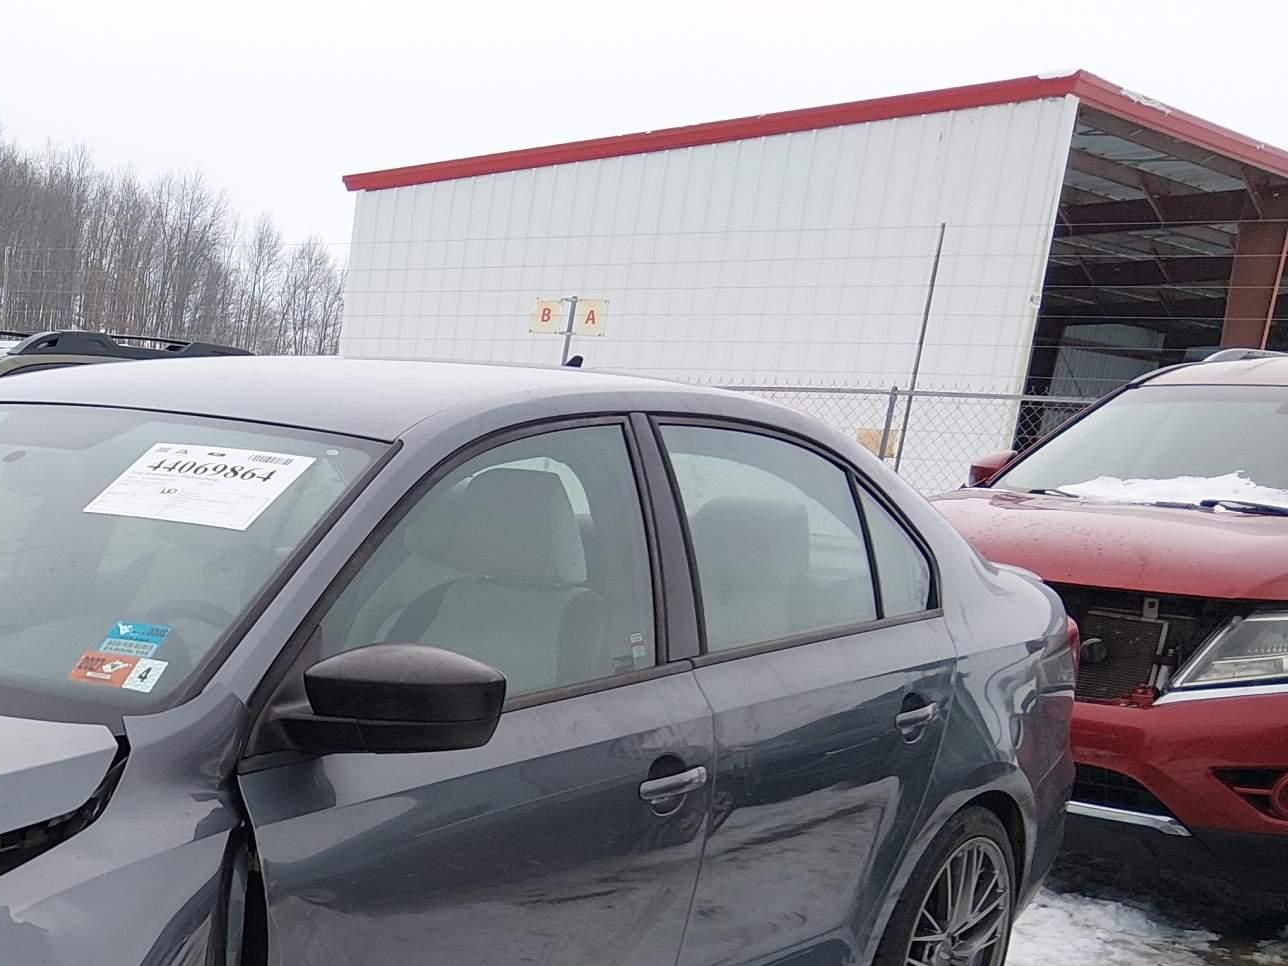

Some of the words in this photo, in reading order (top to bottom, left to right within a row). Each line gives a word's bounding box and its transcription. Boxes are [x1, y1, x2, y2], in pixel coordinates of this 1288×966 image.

[541, 307, 552, 322] B
[584, 310, 596, 324] A
[147, 458, 277, 483] 44069864
[137, 666, 153, 683] 4
